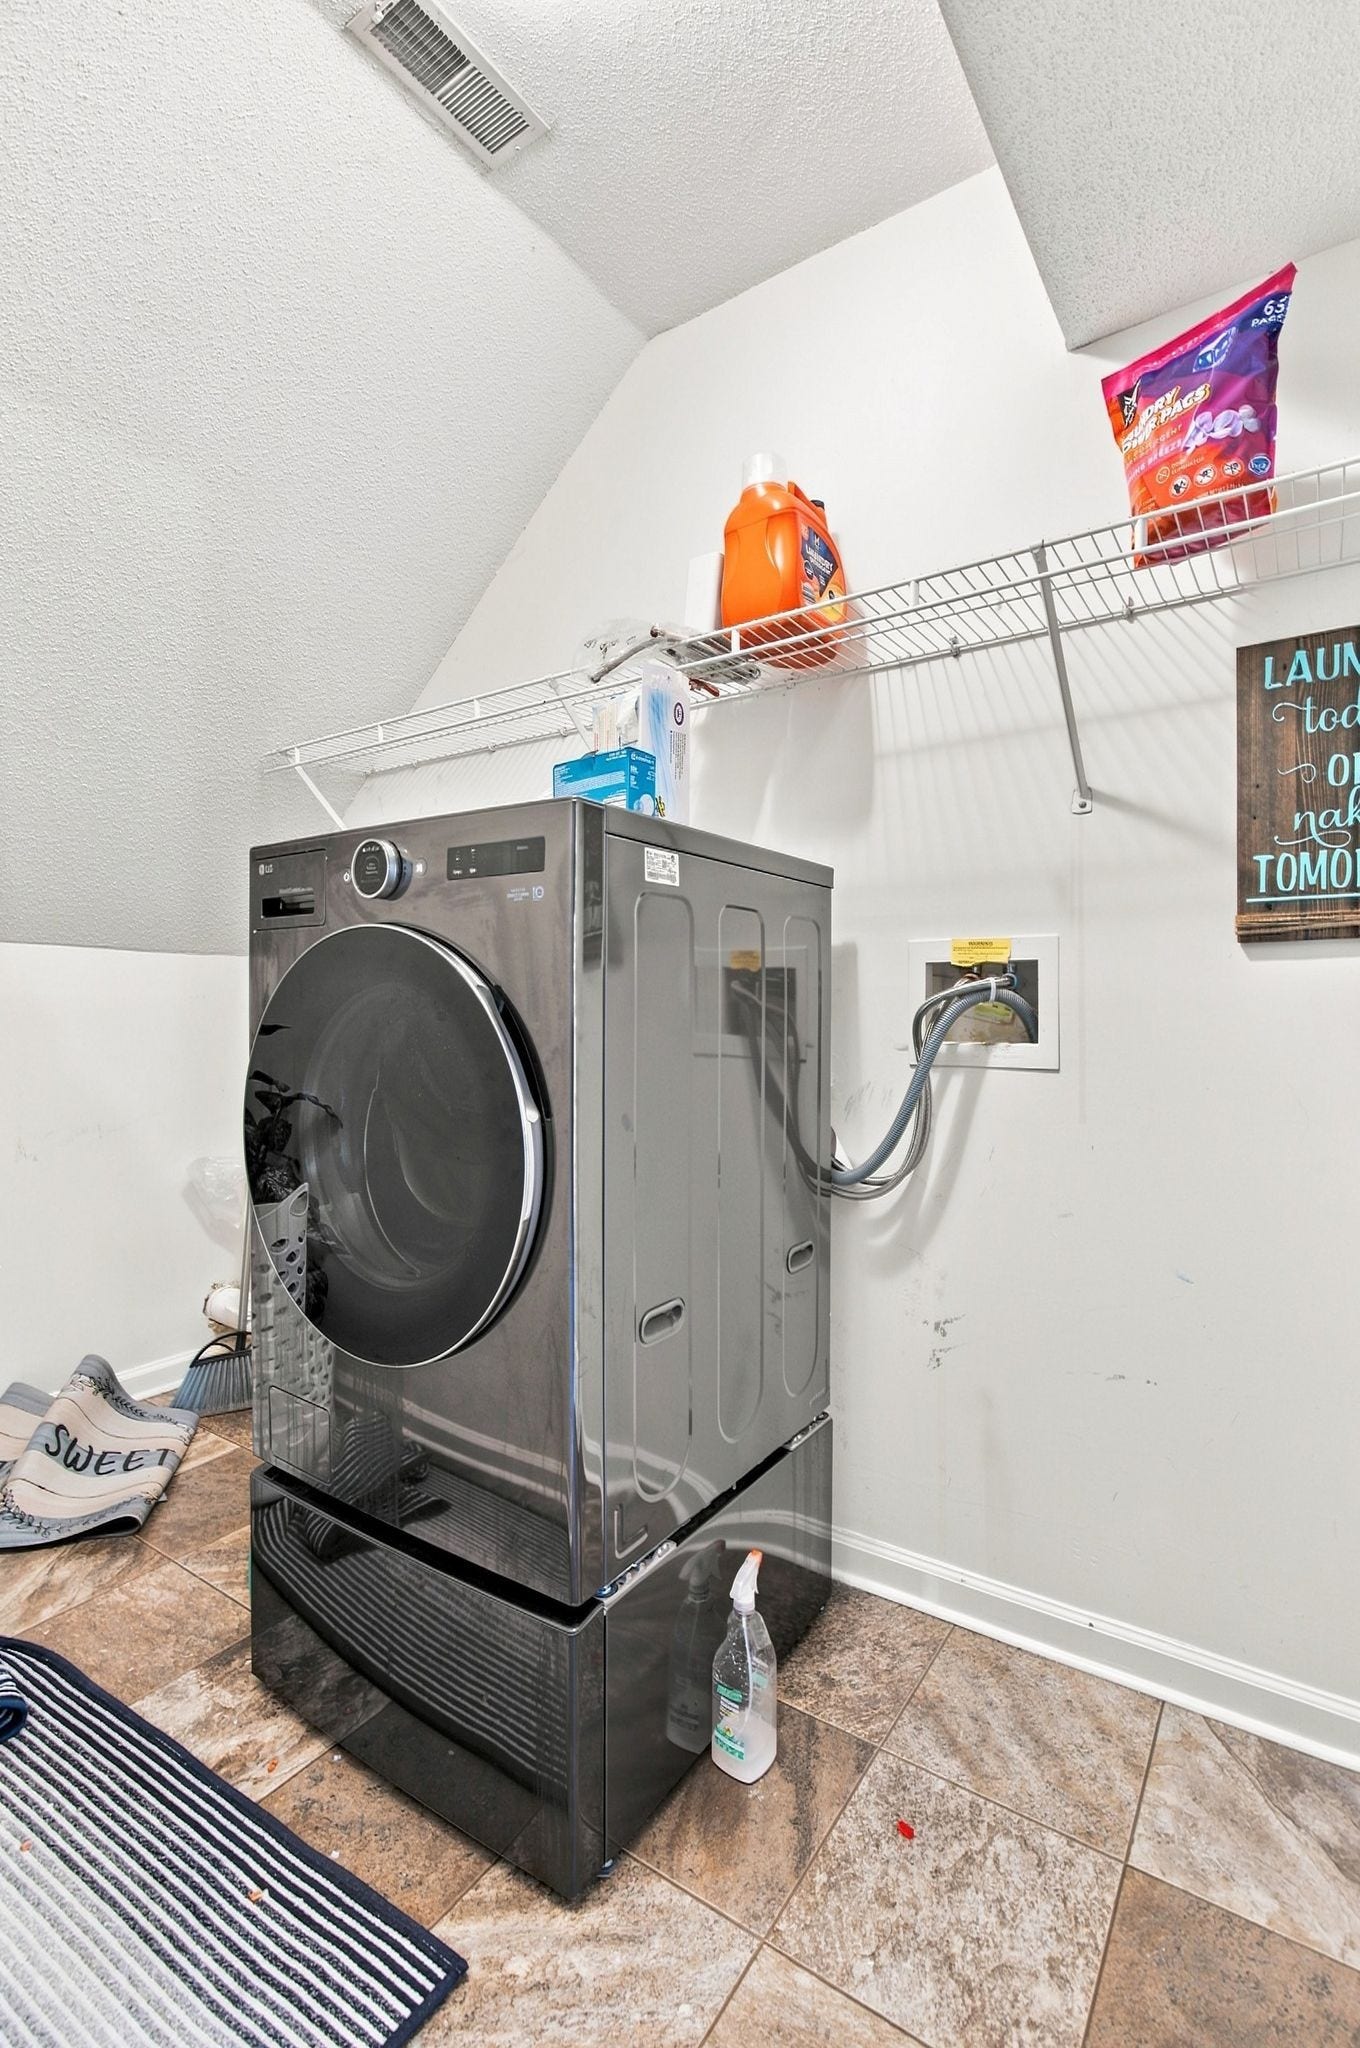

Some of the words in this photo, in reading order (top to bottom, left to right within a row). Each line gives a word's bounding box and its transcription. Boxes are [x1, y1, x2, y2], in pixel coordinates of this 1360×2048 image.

[1264, 641, 1360, 690] LAUN
[1273, 685, 1360, 733] tod
[1276, 785, 1360, 847] nak
[45, 1424, 176, 1475] SWEET
